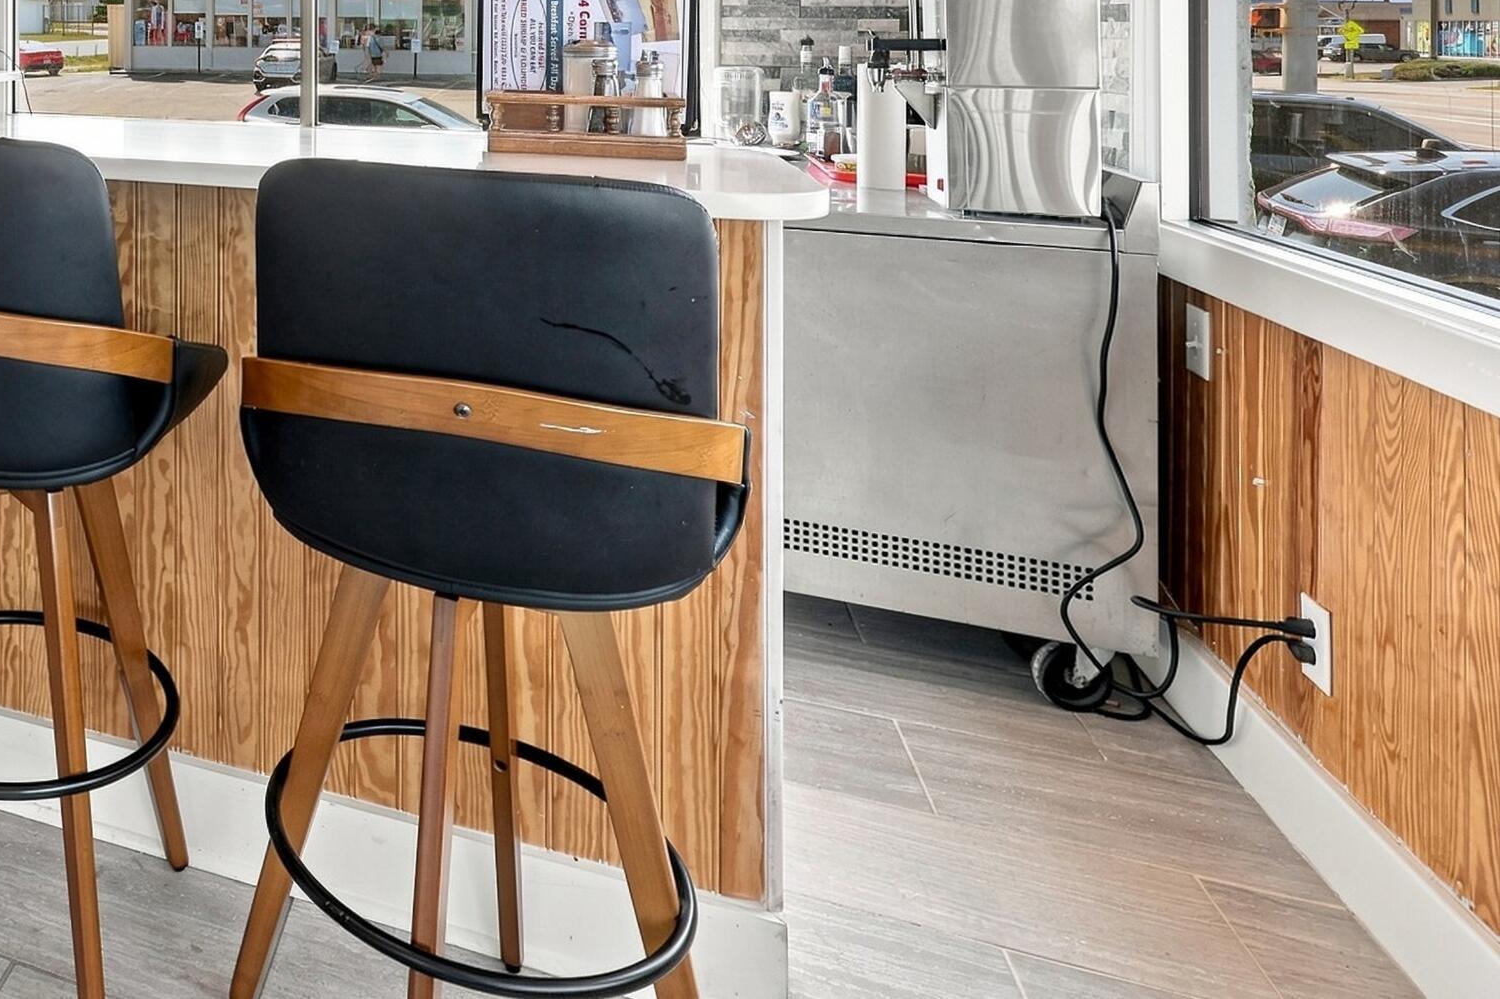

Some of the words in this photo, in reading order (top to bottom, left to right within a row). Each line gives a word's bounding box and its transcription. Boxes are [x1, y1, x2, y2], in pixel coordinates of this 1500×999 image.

[578, 0, 589, 7] 4
[550, 0, 559, 35] Breakfast
[550, 36, 559, 61] Served
[550, 63, 559, 74] All
[548, 76, 559, 91] Day
